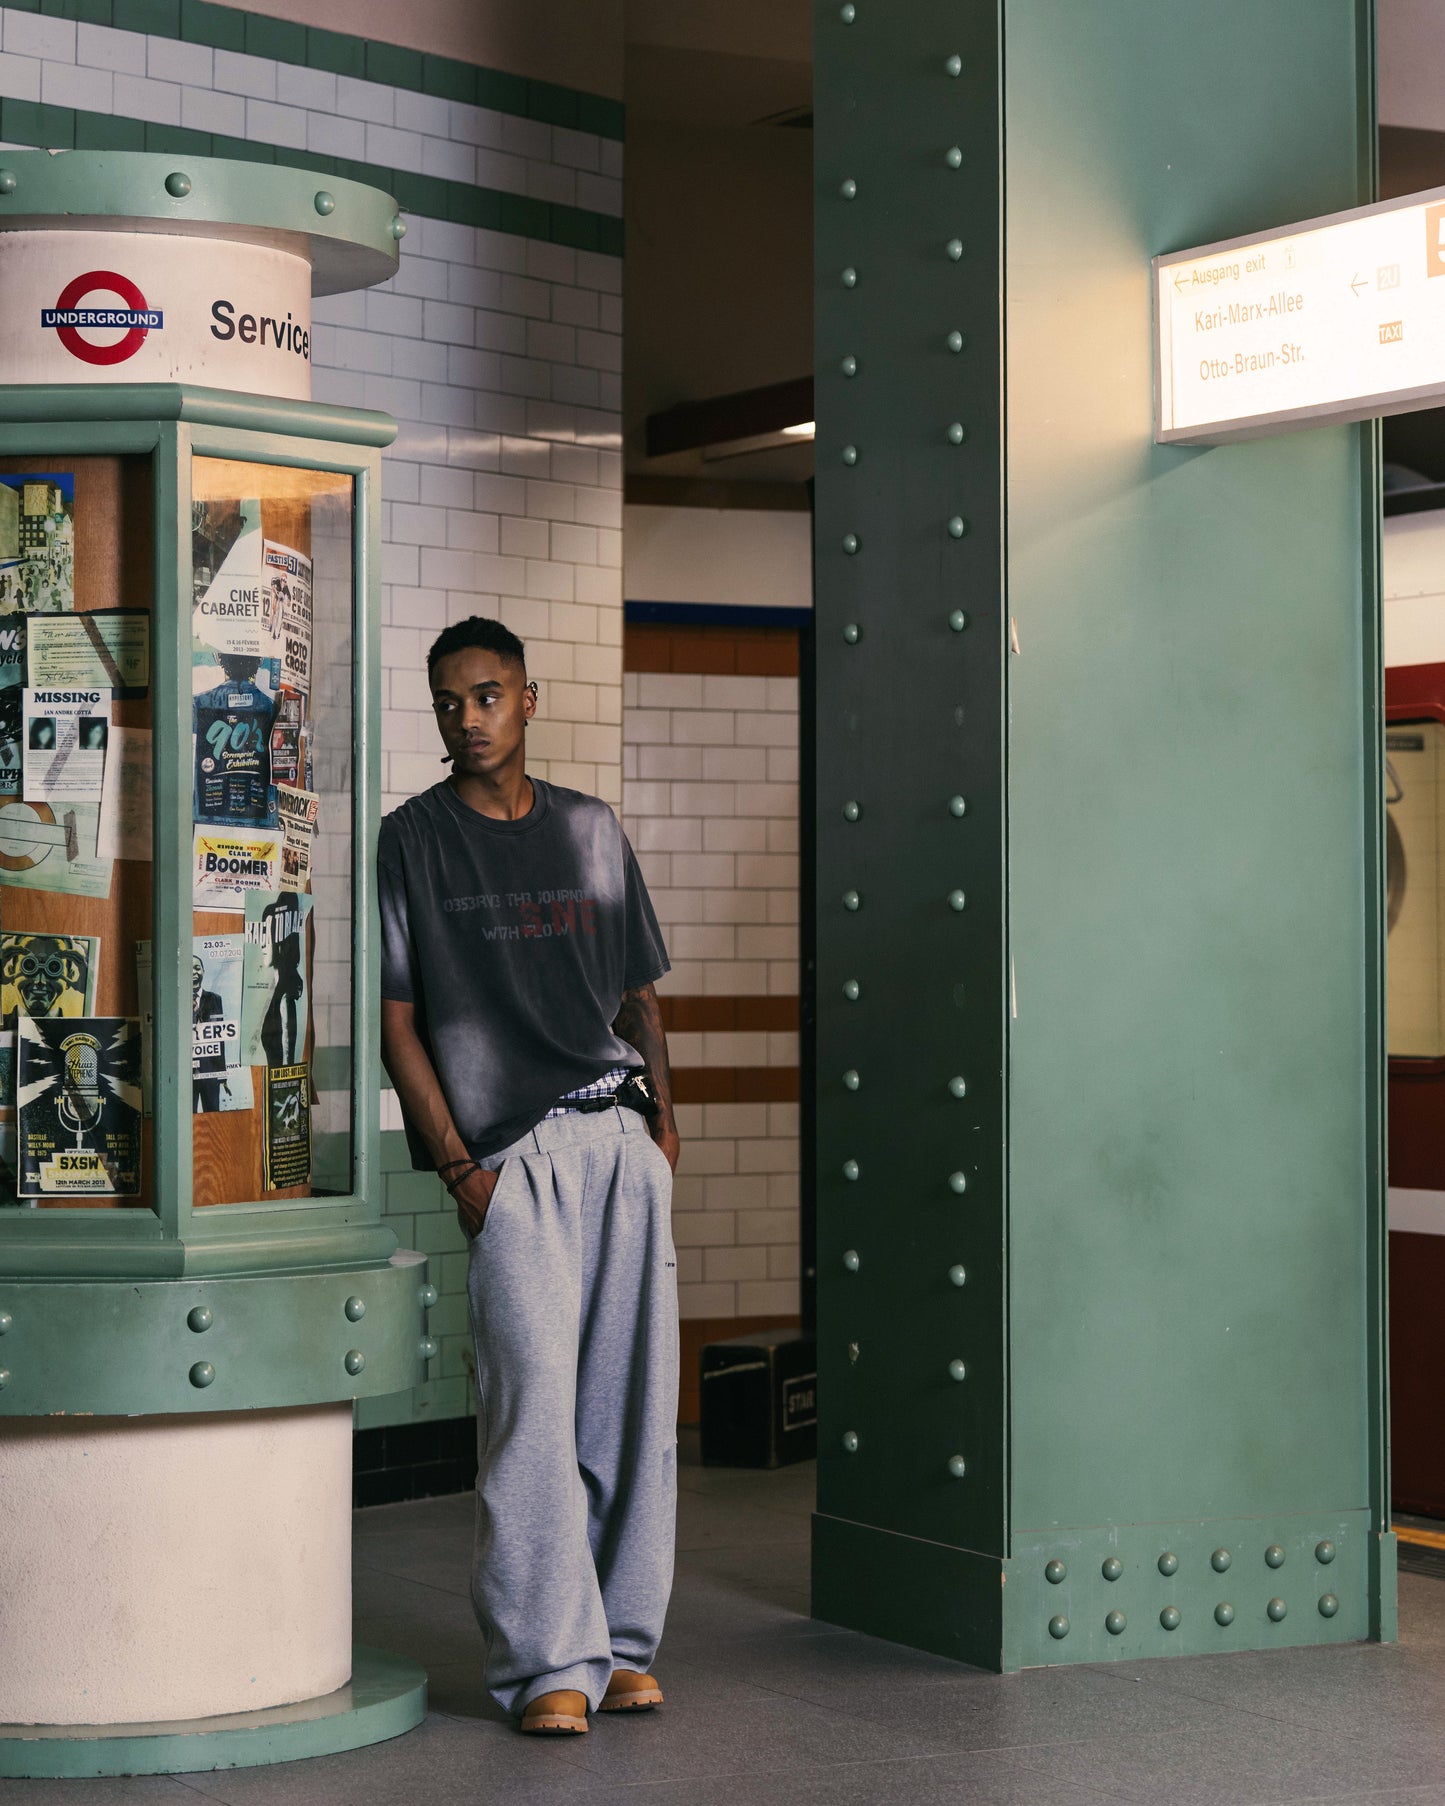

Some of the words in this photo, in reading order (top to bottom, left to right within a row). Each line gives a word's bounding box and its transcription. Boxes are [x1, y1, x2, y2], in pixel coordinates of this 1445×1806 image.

[1191, 262, 1240, 287] Ausgang
[1246, 254, 1266, 273] exit
[45, 312, 159, 326] UNDERGROUND
[1379, 322, 1402, 343] TAXI
[1199, 343, 1305, 381] Otto-Braun-Str.
[230, 587, 259, 603] CINÉ
[201, 602, 259, 617] CABARET
[285, 636, 308, 661] MOTO
[34, 692, 101, 703] MISSING
[205, 852, 268, 876] BOOMER
[60, 1156, 99, 1170] SXSW
